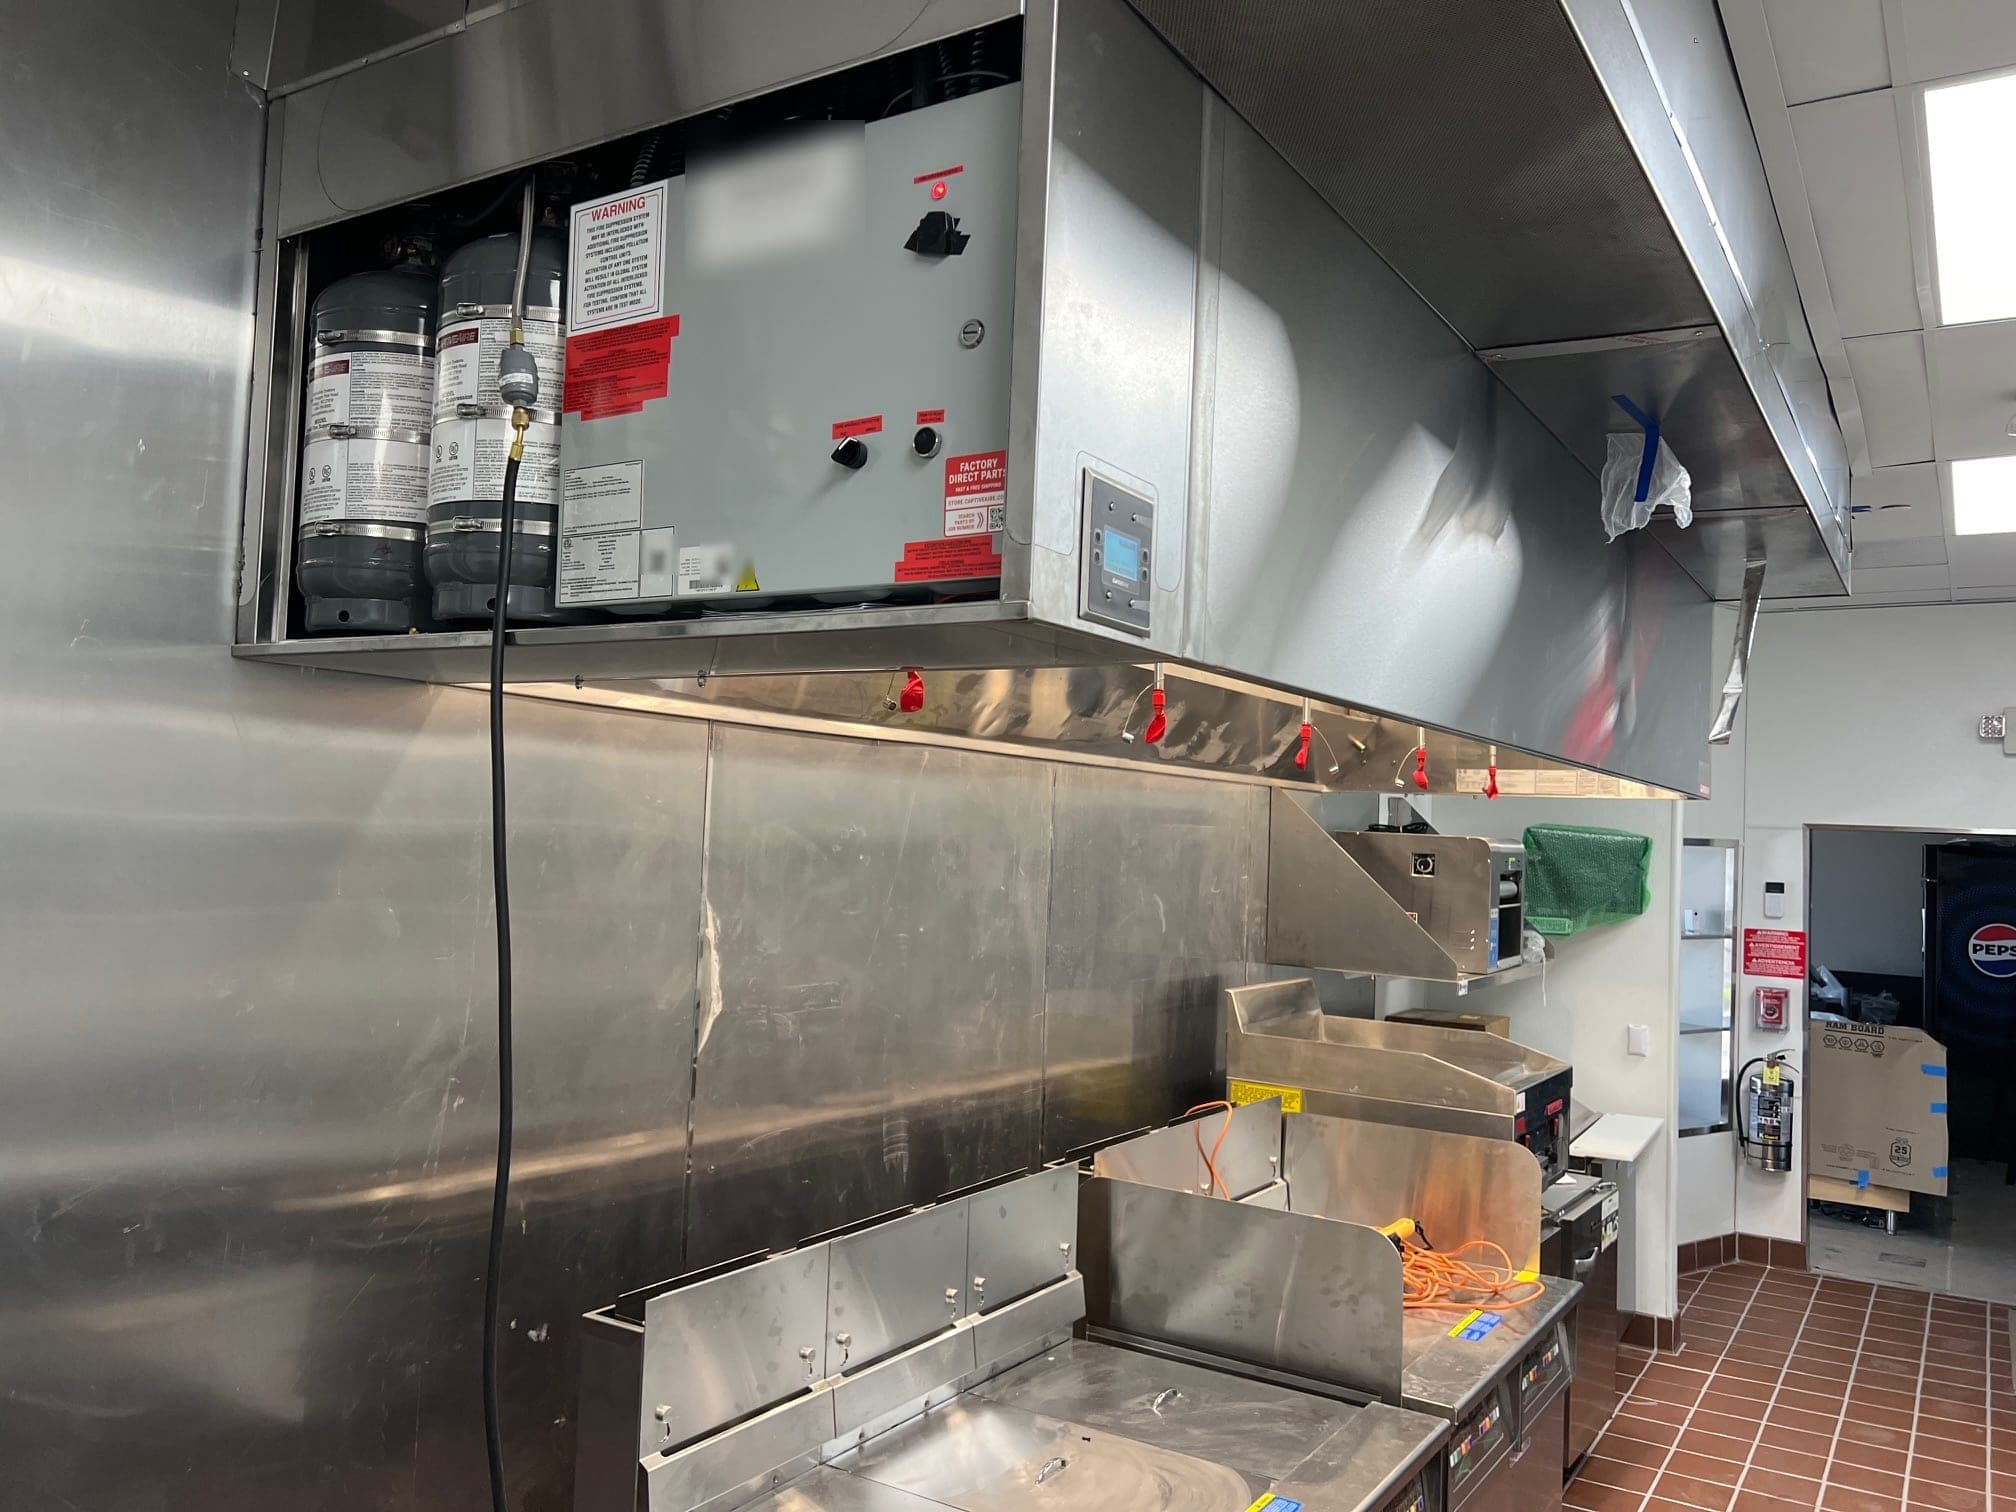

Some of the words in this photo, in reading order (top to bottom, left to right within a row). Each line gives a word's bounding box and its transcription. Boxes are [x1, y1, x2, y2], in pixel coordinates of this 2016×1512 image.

[592, 197, 646, 221] WARNING
[606, 218, 632, 229] SUPPRESSION
[634, 212, 650, 221] SYSTEM
[606, 225, 632, 236] INTERLOCKED
[587, 240, 610, 250] ADDITIONAL
[620, 230, 648, 242] SUPPRESSION
[586, 250, 604, 258] SYSTEMS
[604, 243, 625, 253] INCLUDING
[626, 238, 648, 248] POLLUTION
[585, 265, 607, 274] ACTIVATION
[632, 254, 648, 263] SYSTEM
[600, 254, 618, 264] CONTROL
[595, 272, 610, 280] RESULT
[615, 268, 630, 276] GLOBAL
[632, 262, 648, 272] SYSTEM
[584, 282, 606, 292] ACTIVATION
[620, 272, 648, 282] INTERLOCKED
[596, 286, 623, 298] SUPPRESSION
[610, 293, 628, 302] CONFIRM
[587, 306, 604, 316] SYSTEMS
[960, 458, 998, 472] FACTORY
[949, 471, 980, 484] DIRECT
[948, 495, 1004, 506] STORE.CAPTIVEAIRE.CO
[1972, 944, 2016, 956] PEPS
[1826, 1021, 1847, 1031] RAM
[1850, 1024, 1884, 1034] BOARD
[1894, 1146, 1908, 1154] 25
